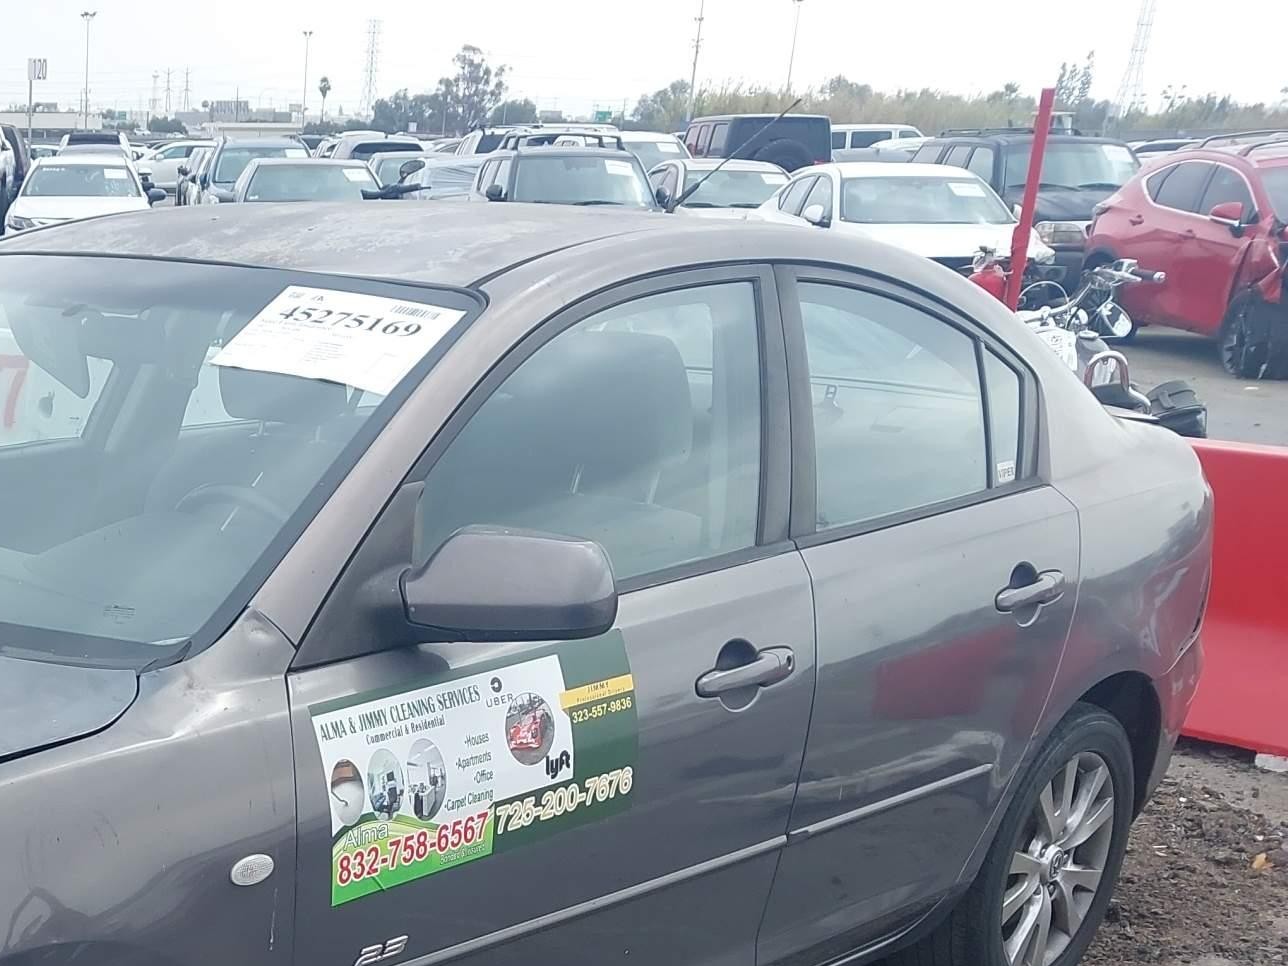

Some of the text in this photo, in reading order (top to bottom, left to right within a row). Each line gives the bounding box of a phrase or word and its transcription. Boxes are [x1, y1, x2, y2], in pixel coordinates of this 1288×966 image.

[33, 59, 47, 80] 120
[279, 305, 422, 337] 45275169
[320, 685, 481, 742] ALMA & JIMMY CLEANING SERVICES
[486, 693, 513, 708] UBER
[572, 696, 632, 724] 323-557-9836
[366, 715, 445, 745] Commercial & Residential
[545, 750, 571, 779] lyft
[467, 789, 494, 806] Cleaning
[496, 766, 632, 834] 725-200-7676
[338, 811, 489, 886] 832-758-6567
[344, 824, 388, 849] Alma
